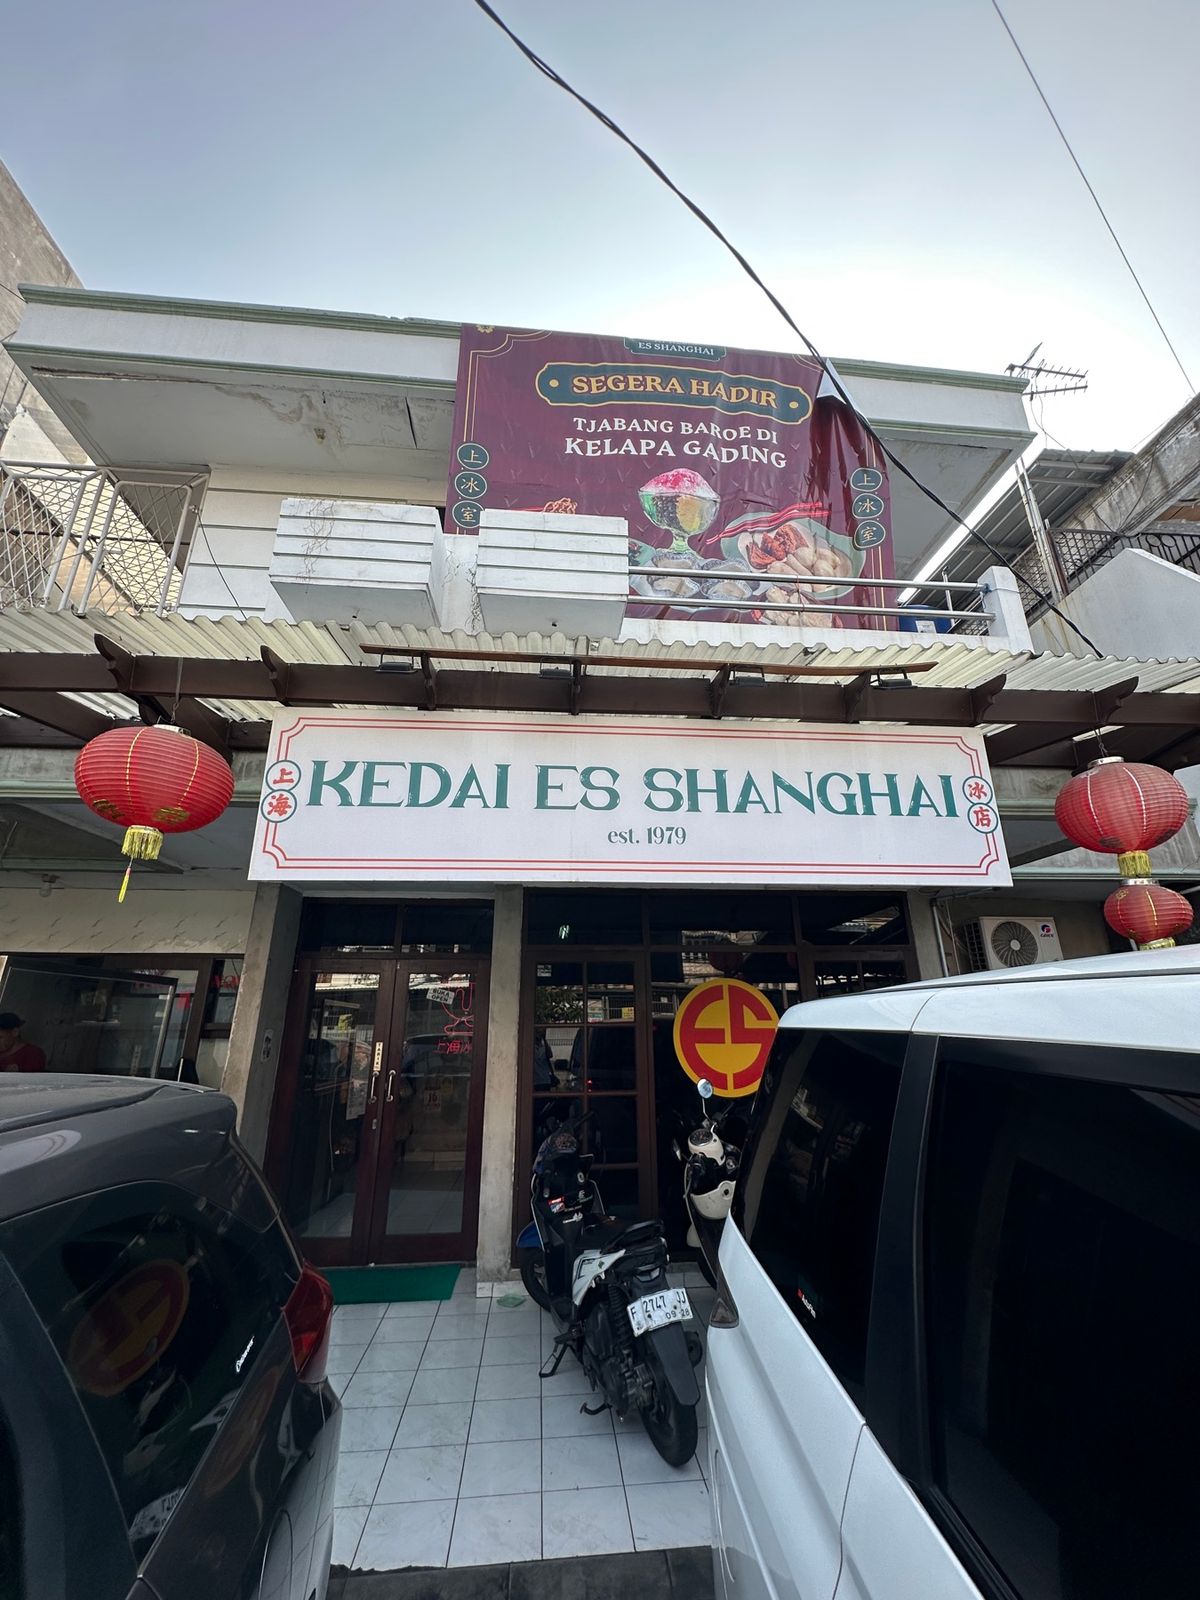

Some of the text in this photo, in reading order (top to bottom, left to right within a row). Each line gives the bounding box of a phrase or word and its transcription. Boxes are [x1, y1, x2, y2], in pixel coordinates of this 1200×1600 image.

[638, 341, 714, 356] ES SHANGHAI
[572, 374, 778, 409] SEGERA HADIR
[573, 417, 779, 444] TJABANG BAROE DI
[564, 438, 787, 469] KELAPA GADING
[305, 760, 960, 818] KEDAI ES SHANGHAI
[607, 826, 687, 845] est. 1979
[630, 1306, 637, 1320] F
